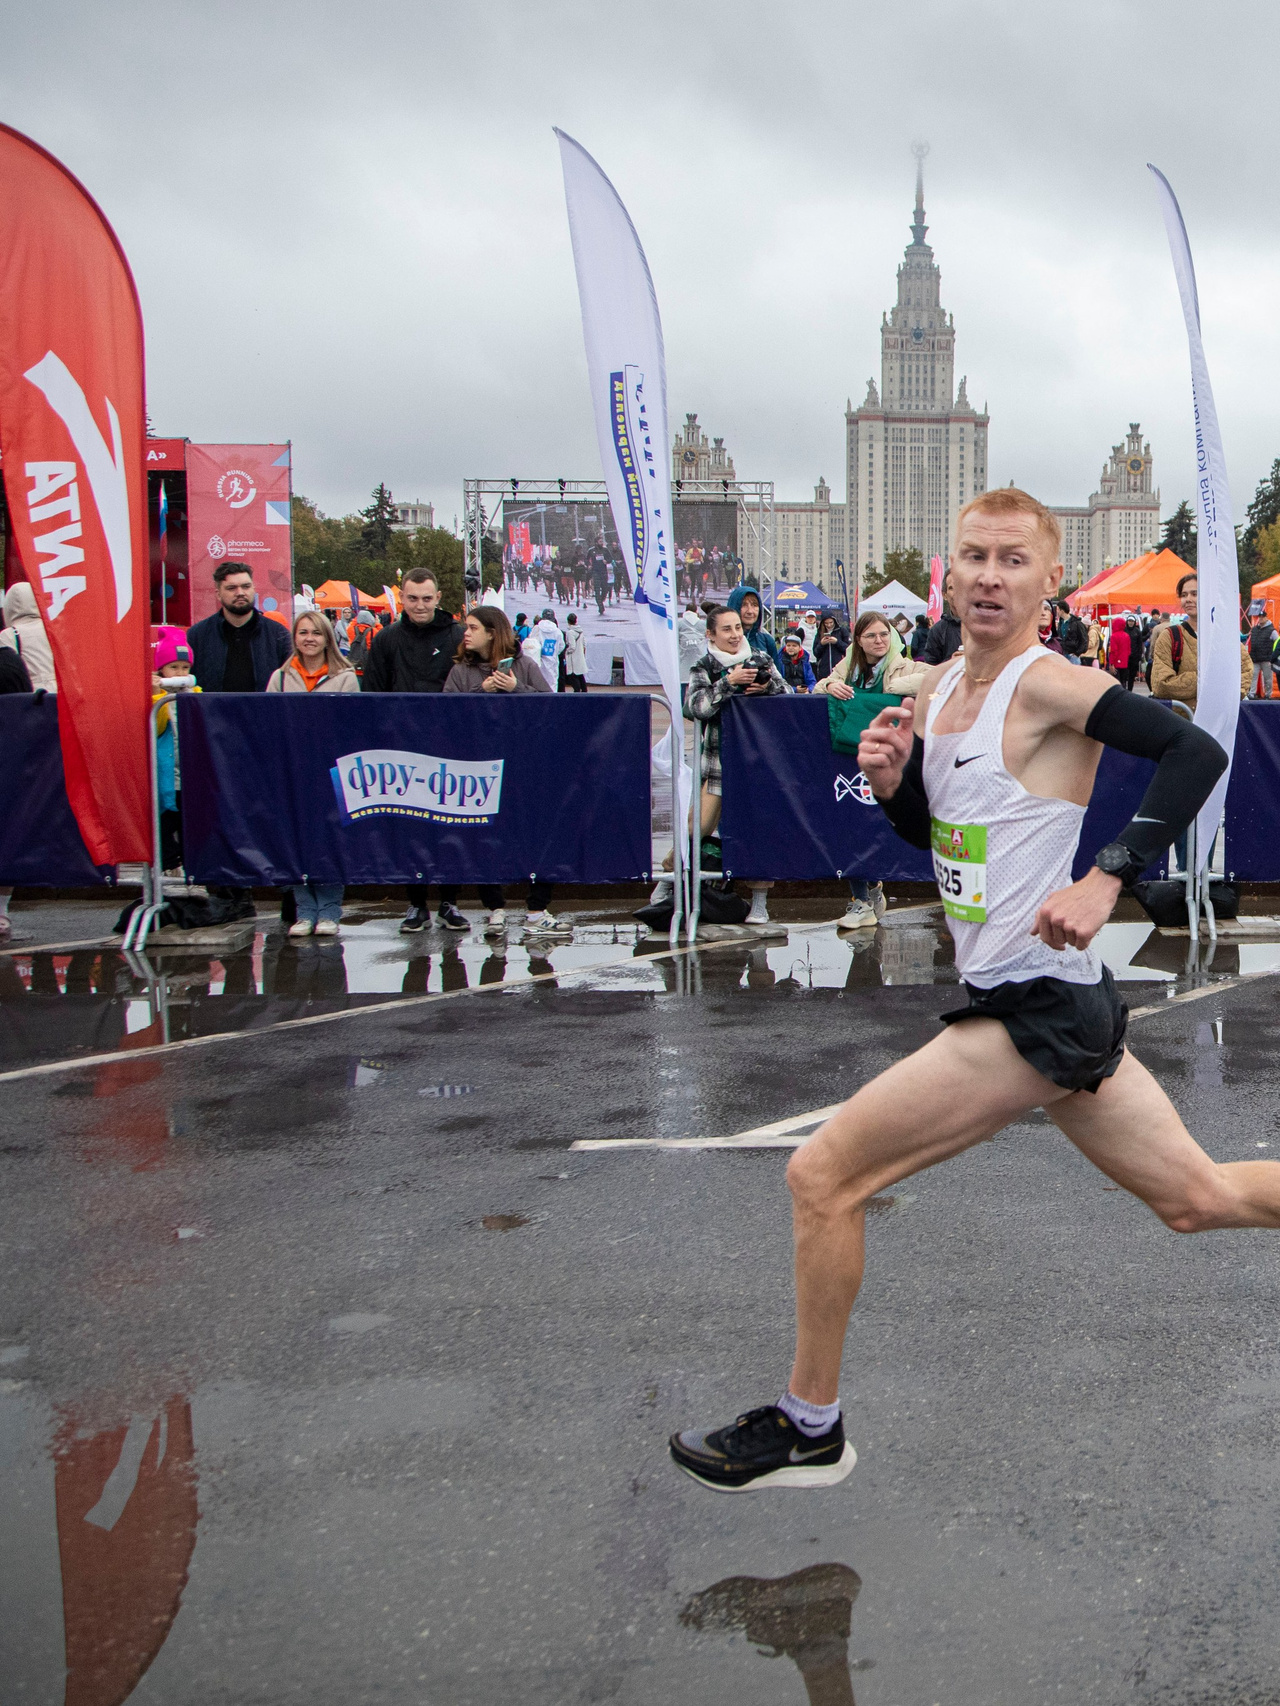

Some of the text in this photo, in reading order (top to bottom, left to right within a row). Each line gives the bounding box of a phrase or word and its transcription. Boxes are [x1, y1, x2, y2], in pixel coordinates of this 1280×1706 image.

[226, 470, 255, 485] RUNNING
[228, 540, 264, 548] pharmeco
[348, 756, 499, 807] фру-фру
[350, 807, 489, 824] жевательный мармелад
